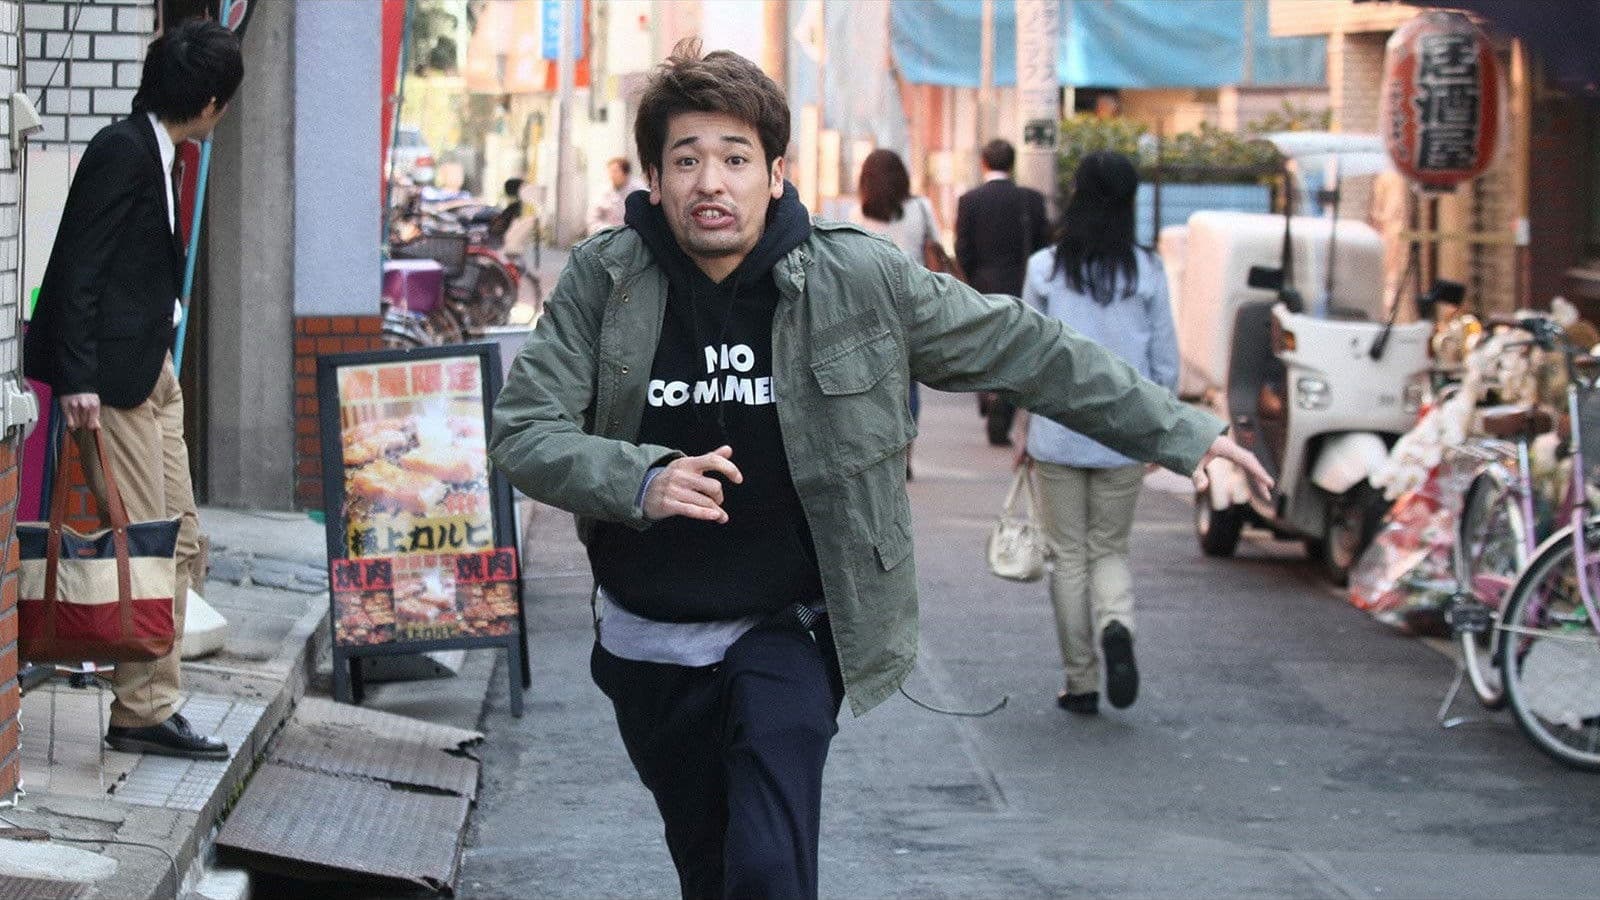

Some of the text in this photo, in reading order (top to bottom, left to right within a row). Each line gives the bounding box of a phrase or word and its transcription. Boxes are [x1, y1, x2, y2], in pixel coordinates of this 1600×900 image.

[1417, 34, 1479, 169] 居酒屋
[704, 344, 755, 374] NO
